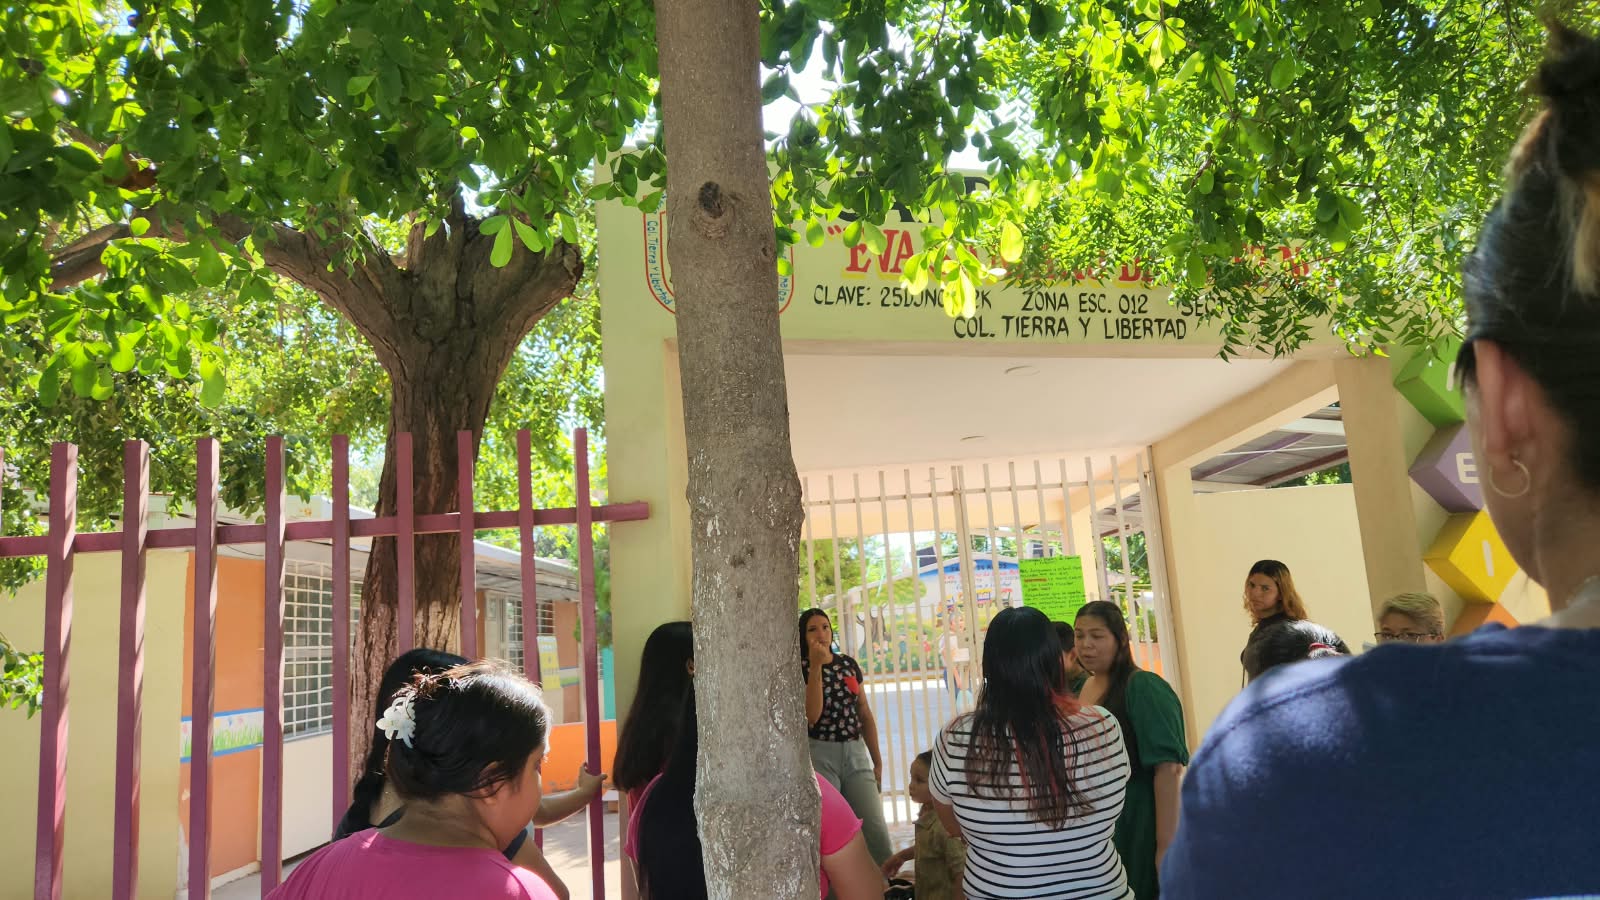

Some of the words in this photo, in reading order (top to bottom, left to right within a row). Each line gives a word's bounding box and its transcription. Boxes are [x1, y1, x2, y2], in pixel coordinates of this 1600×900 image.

[813, 284, 872, 306] CLAVE:
[1021, 291, 1070, 312] ZONA
[1079, 292, 1112, 314] ESC.
[953, 315, 995, 339] COL.
[1002, 315, 1070, 338] TIERRA
[1078, 316, 1091, 338] Y
[1103, 317, 1187, 340] LIBERTAD
